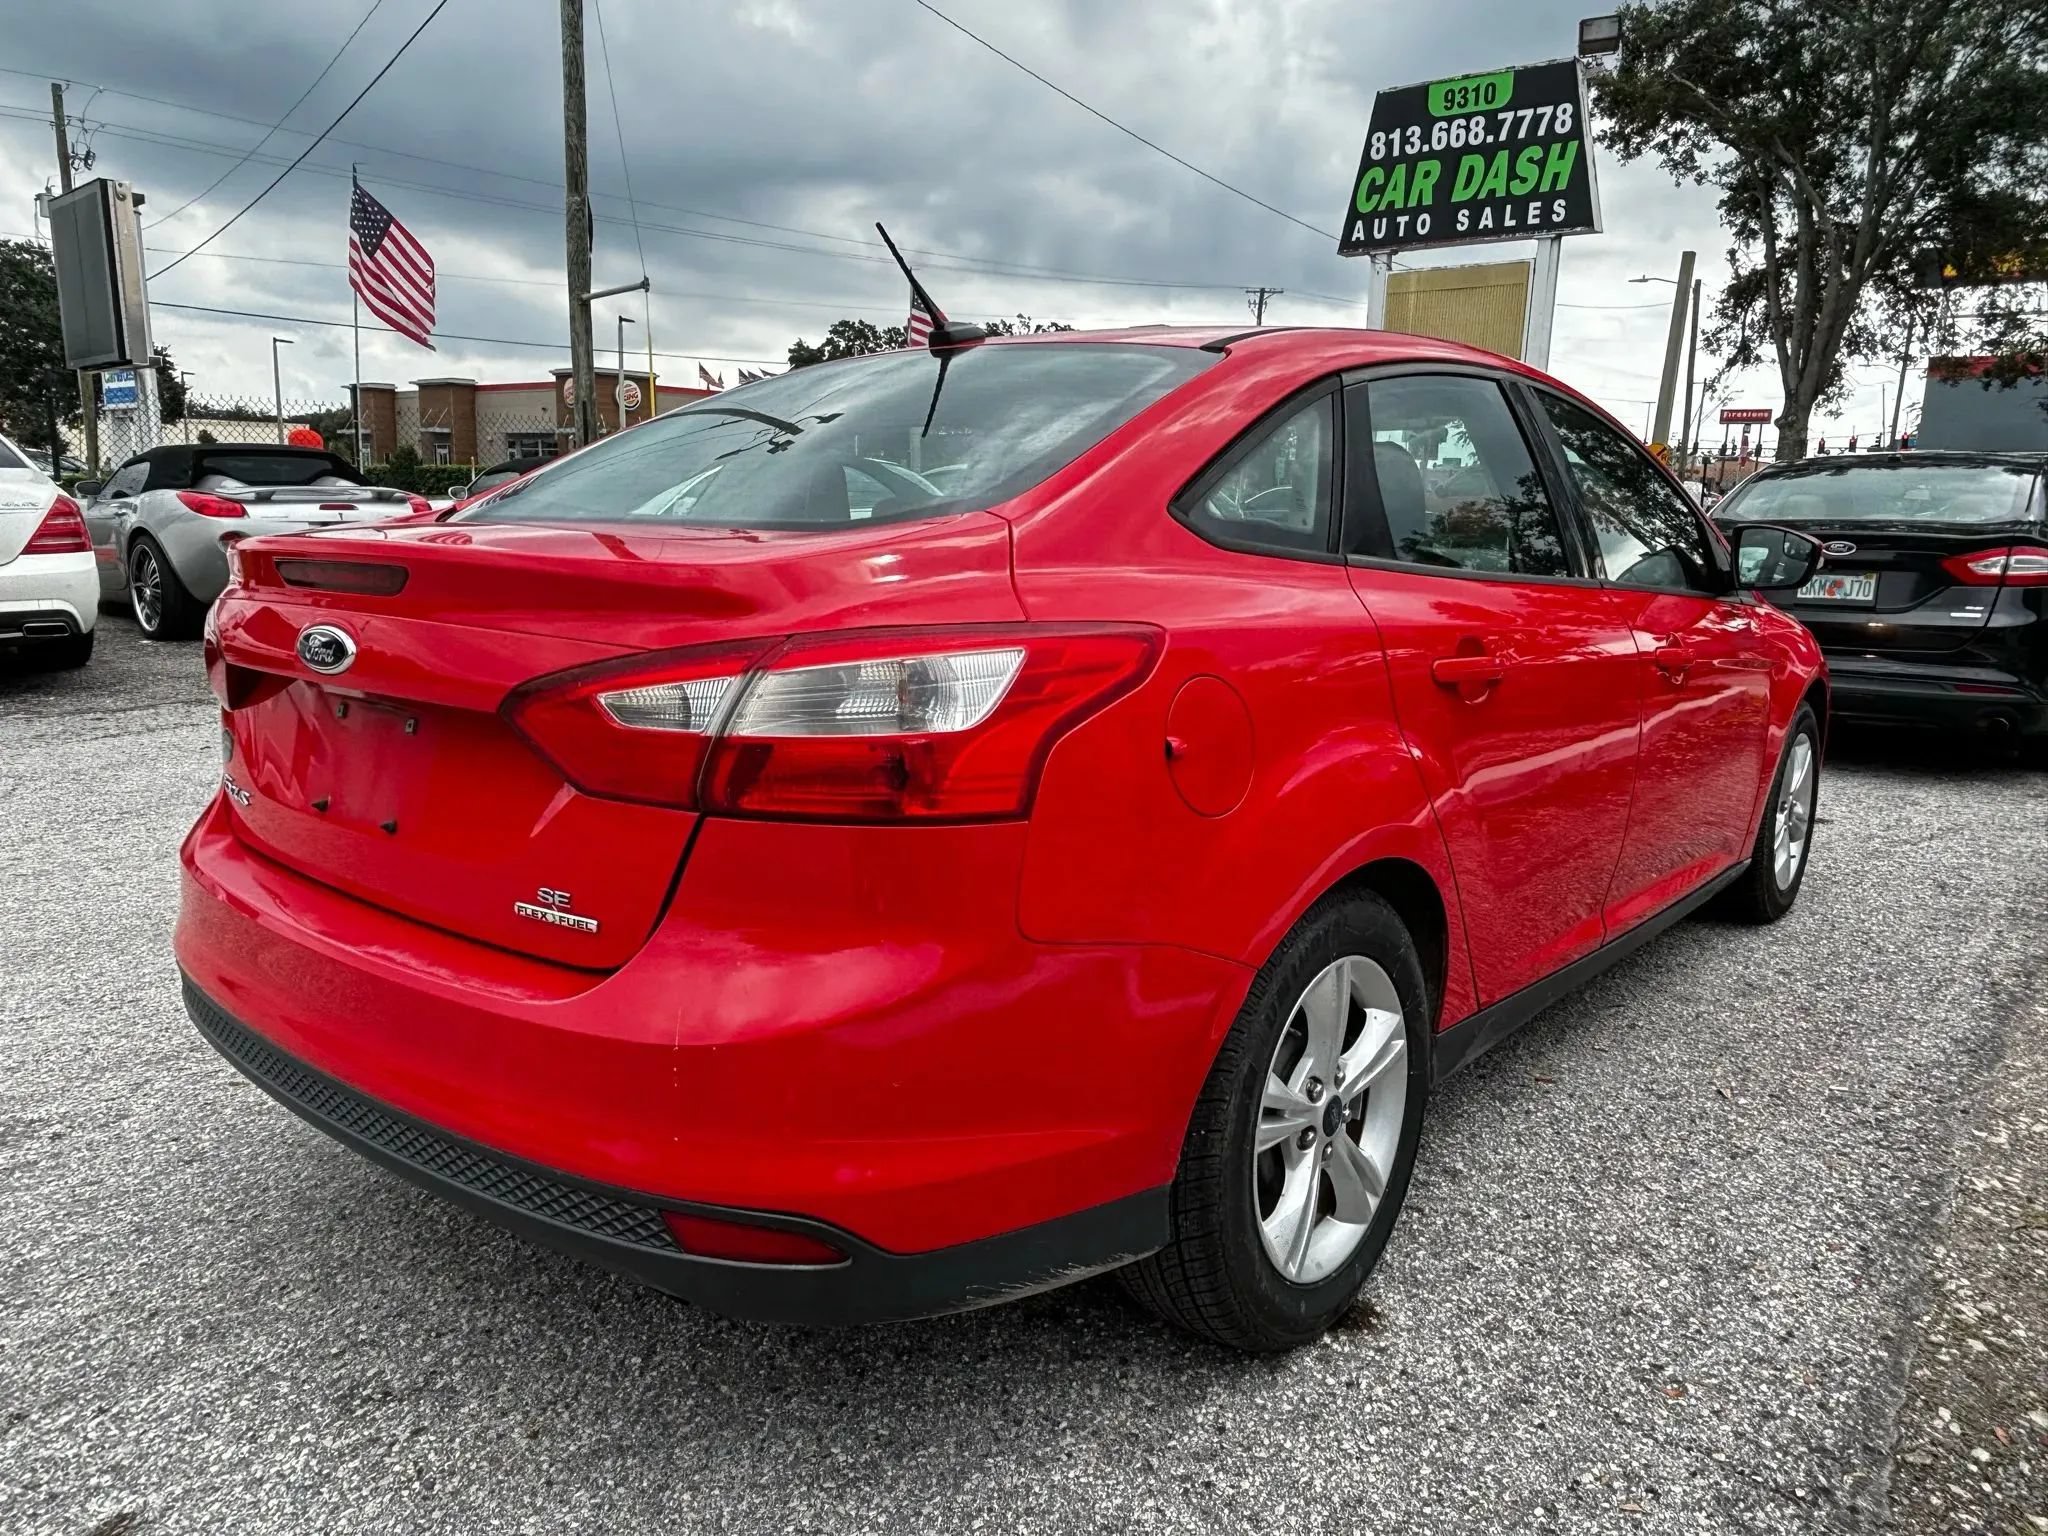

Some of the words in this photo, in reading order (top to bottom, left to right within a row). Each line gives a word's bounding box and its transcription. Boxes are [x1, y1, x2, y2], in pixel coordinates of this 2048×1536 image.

[1443, 81, 1497, 112] 9310
[1370, 102, 1574, 161] 813.668.7778
[1356, 159, 1441, 214] CAR
[1451, 140, 1579, 203] DASH
[1351, 213, 1431, 243] AUTO
[1456, 198, 1567, 231] SALES
[305, 634, 335, 663] Ford
[537, 887, 571, 908] SE
[517, 904, 549, 922] FLEX
[559, 915, 595, 932] FUEL
